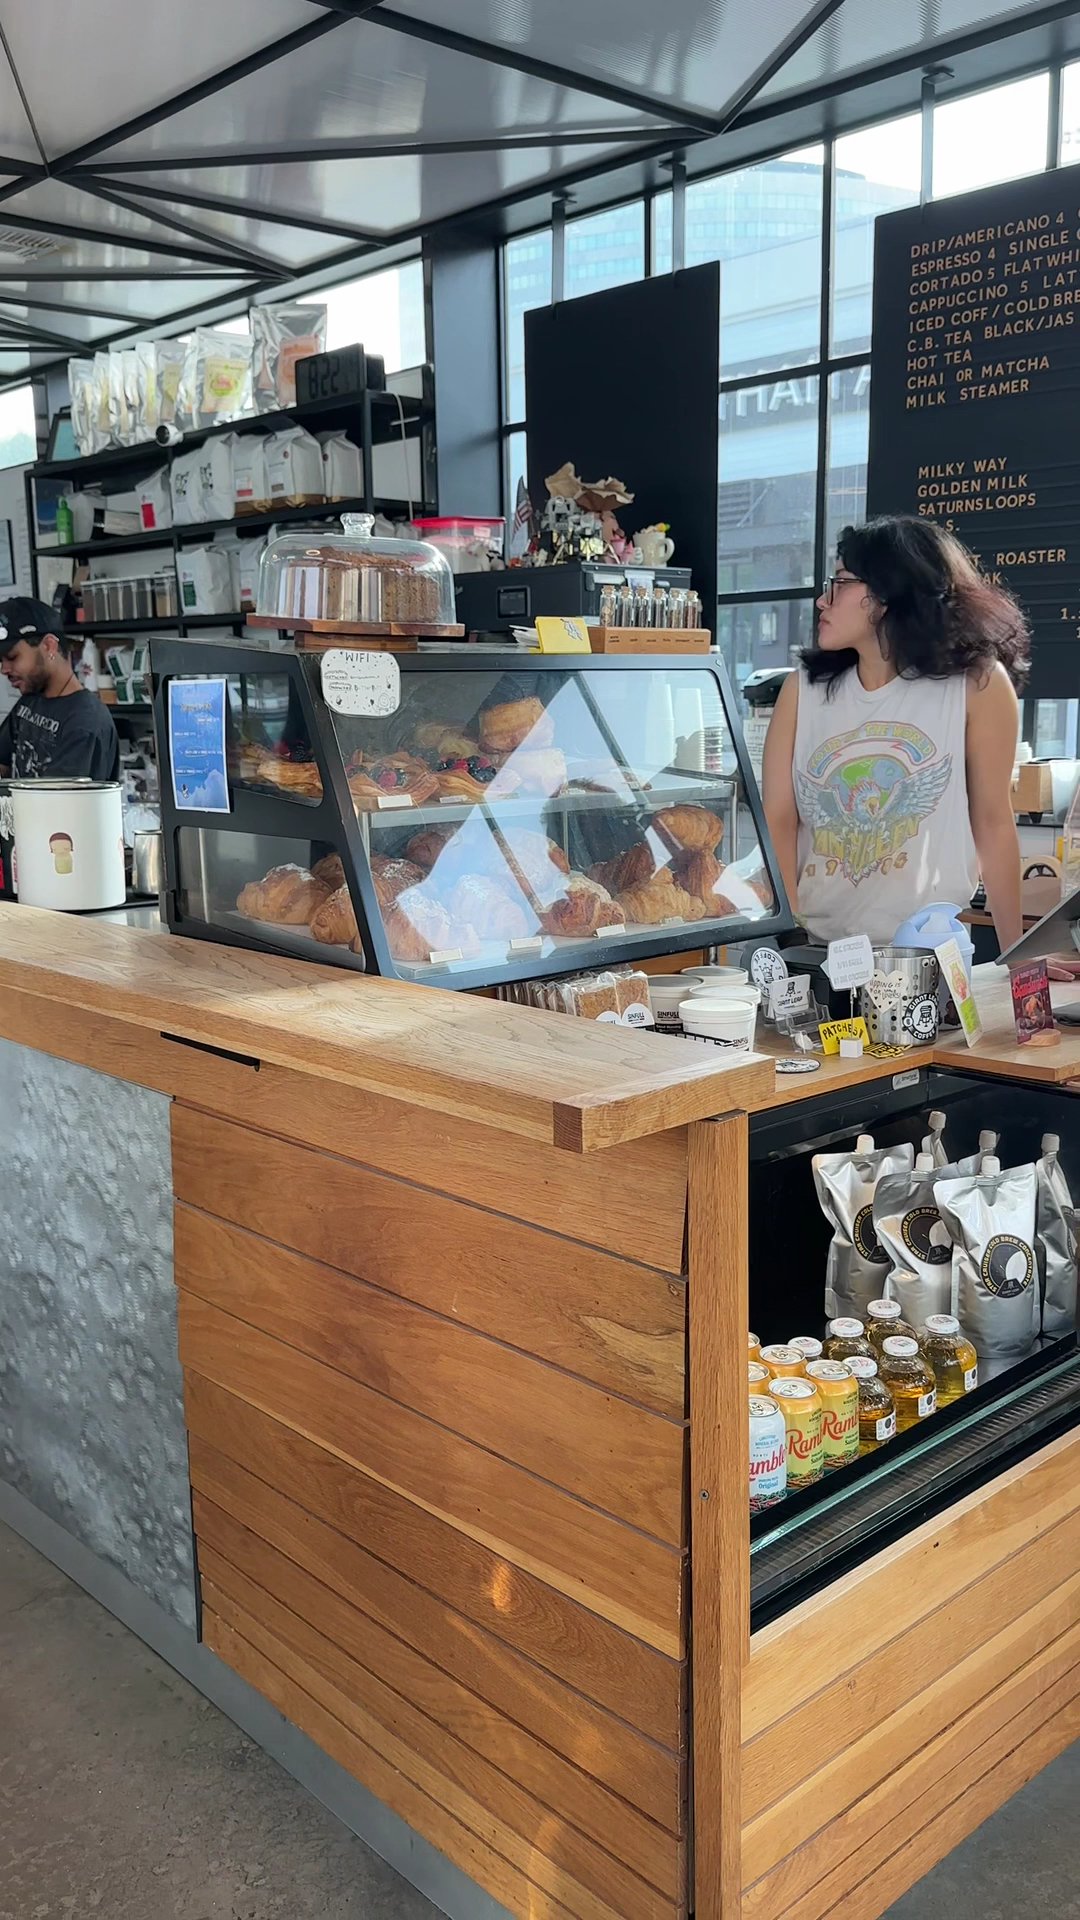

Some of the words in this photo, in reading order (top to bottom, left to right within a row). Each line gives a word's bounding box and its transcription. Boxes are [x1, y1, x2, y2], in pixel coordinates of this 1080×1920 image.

[911, 214, 1050, 259] DRIP/AMERICANO
[1055, 211, 1065, 224] 4
[911, 250, 981, 277] ESPRESSO
[987, 247, 996, 260] 4
[1008, 230, 1070, 256] SINGLE
[909, 269, 983, 296] CORTADO
[987, 267, 995, 281] 5
[1004, 256, 1043, 277] FLAT
[909, 283, 1008, 315] CAPPUCCINO
[1019, 280, 1029, 293] 5
[1043, 269, 1080, 289] LAT
[907, 337, 940, 353] C.B.
[944, 330, 973, 346] TEA
[984, 311, 1074, 340] BLACK/JAS
[909, 315, 945, 334] ICED
[907, 355, 938, 372] HOT
[944, 349, 973, 365] TEA
[907, 372, 945, 390] CHAI
[956, 368, 973, 383] OR
[981, 355, 1050, 379] MATCHA
[906, 391, 946, 409] MILK
[959, 378, 1030, 401] STEAMER
[918, 461, 965, 479] MILKY
[973, 457, 1008, 473] WAY
[917, 479, 981, 498] GOLDEN
[987, 474, 1028, 490] MILK
[996, 549, 1066, 566] ROASTER
[345, 652, 369, 663] WIFI
[865, 723, 889, 737] THE
[909, 994, 927, 1010] GIANT
[906, 1209, 920, 1221] COLD
[982, 1249, 992, 1277] CRUISER
[1000, 1236, 1019, 1244] BREW
[1018, 1242, 1032, 1288] CONCENTRATE
[758, 1480, 779, 1489] Original
